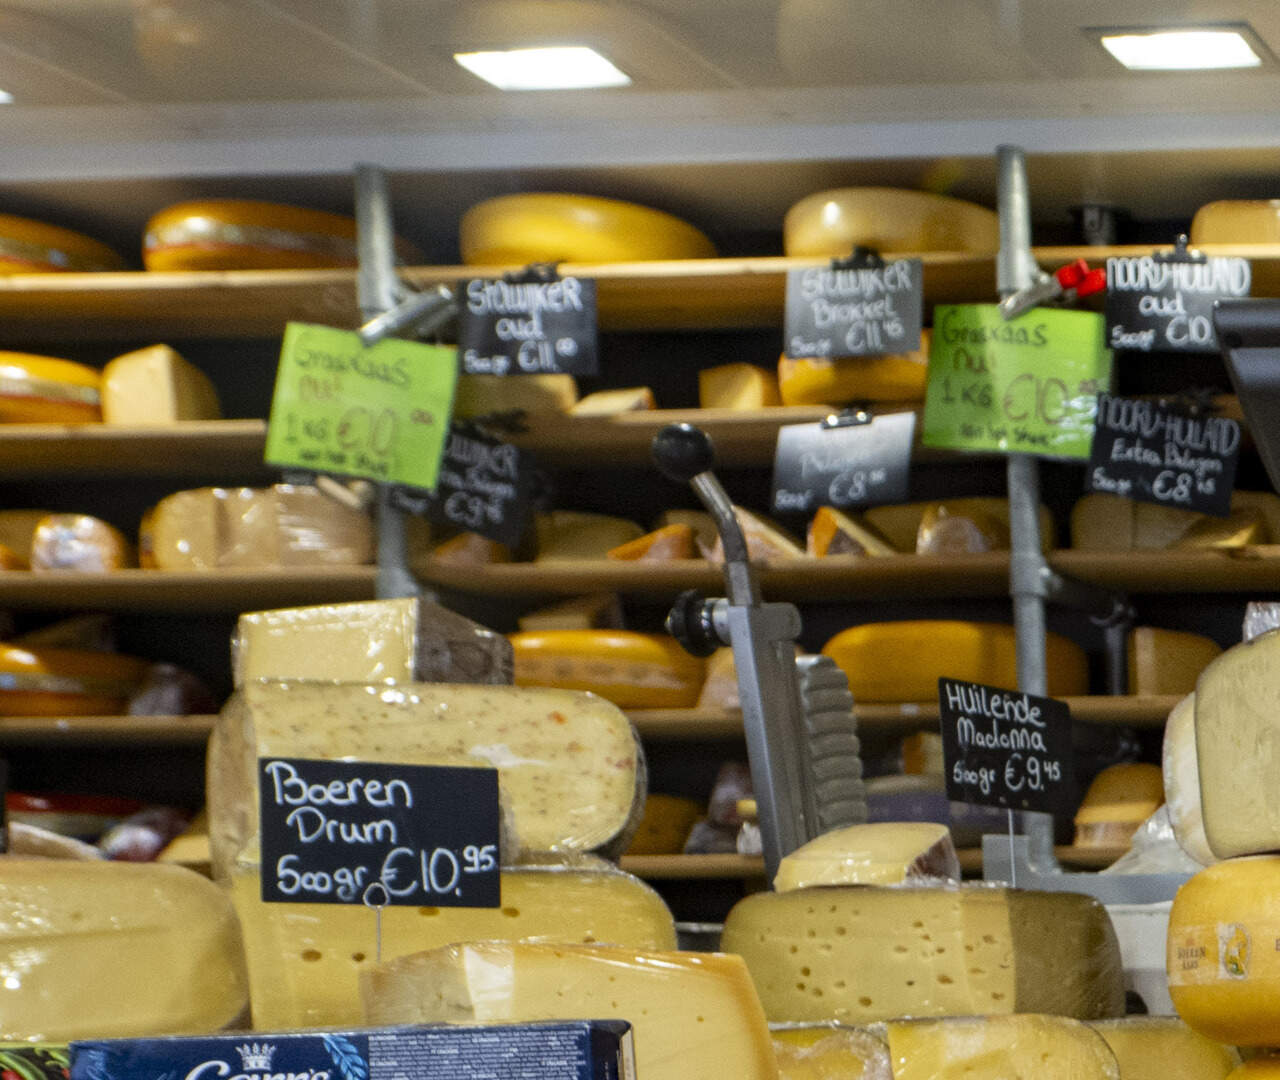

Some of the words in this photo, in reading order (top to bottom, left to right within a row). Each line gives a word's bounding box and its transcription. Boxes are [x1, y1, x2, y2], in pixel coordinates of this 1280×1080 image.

[1138, 290, 1188, 317] oud
[956, 716, 1048, 753] Madonna
[265, 761, 413, 808] Boeren
[286, 806, 397, 844] Drum
[277, 854, 368, 900] 500gr
